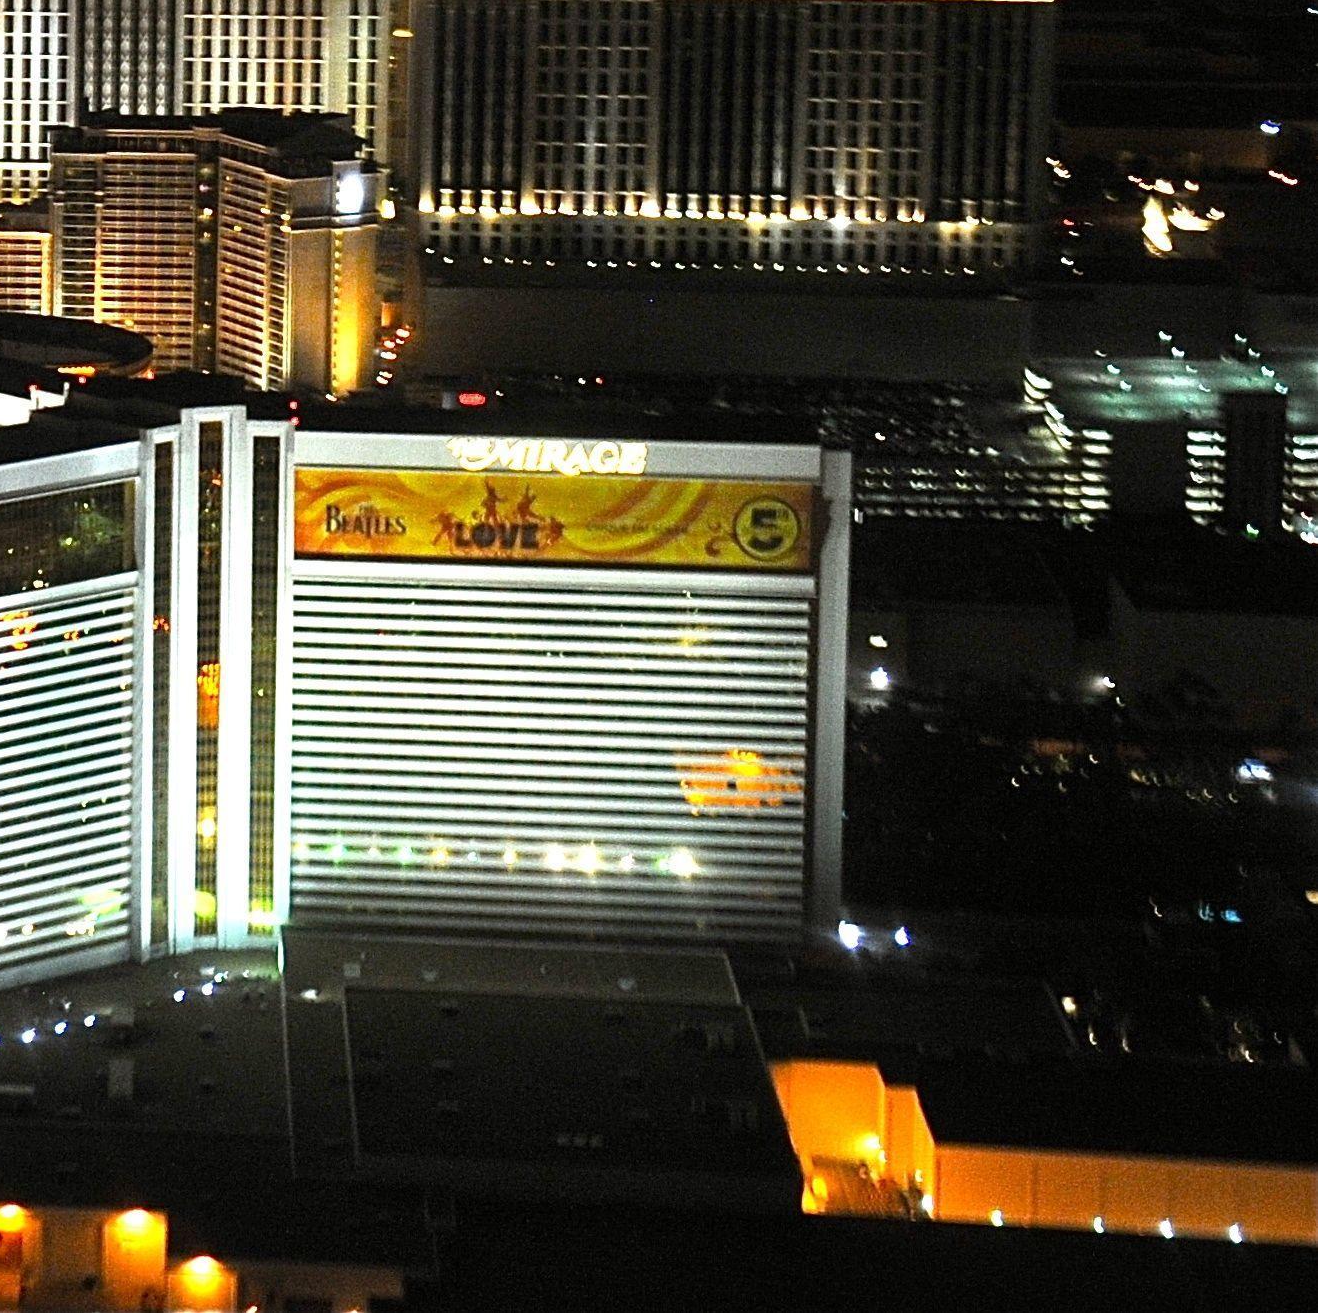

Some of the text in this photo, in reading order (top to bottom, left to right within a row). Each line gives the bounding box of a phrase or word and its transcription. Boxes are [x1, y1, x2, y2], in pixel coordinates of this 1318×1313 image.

[496, 439, 648, 476] MIRAGE
[325, 504, 407, 537] BEATLES
[454, 521, 541, 549] LOVE
